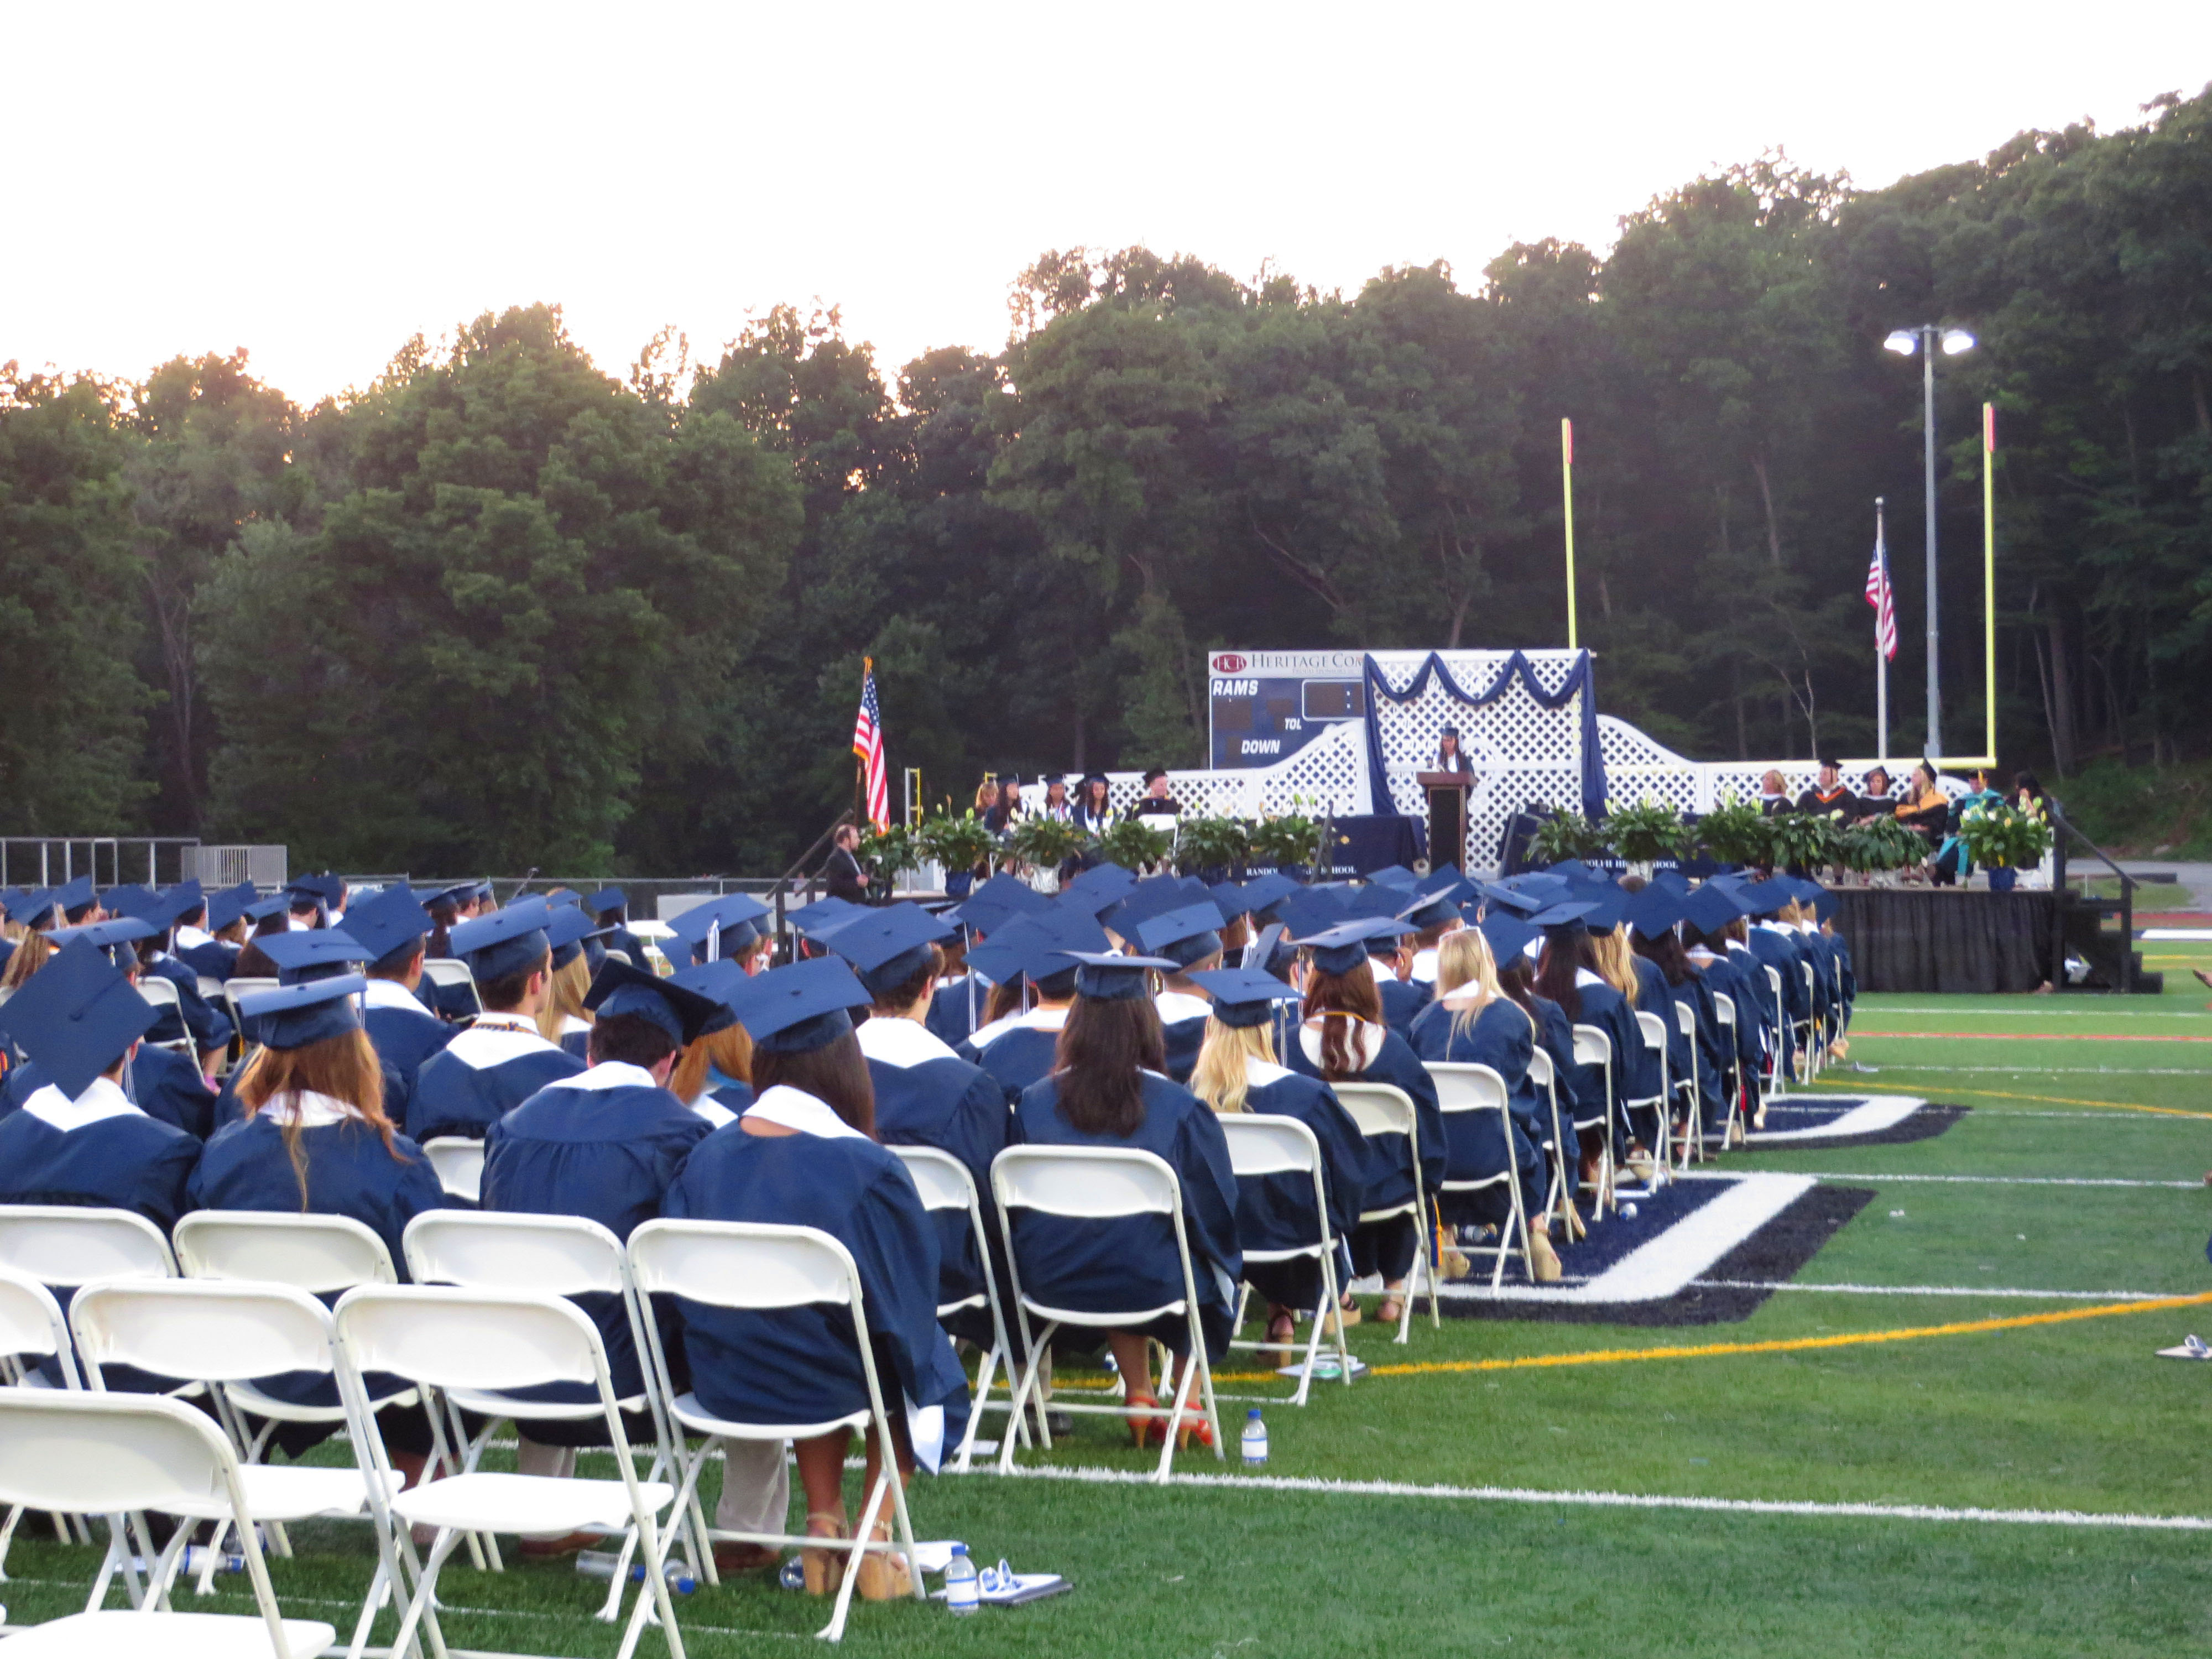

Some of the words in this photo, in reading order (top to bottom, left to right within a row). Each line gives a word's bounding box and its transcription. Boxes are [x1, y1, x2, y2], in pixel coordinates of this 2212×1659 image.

[1213, 680, 1258, 696] RAMS
[1285, 718, 1302, 731] TOL
[1241, 740, 1280, 754] DOWN
